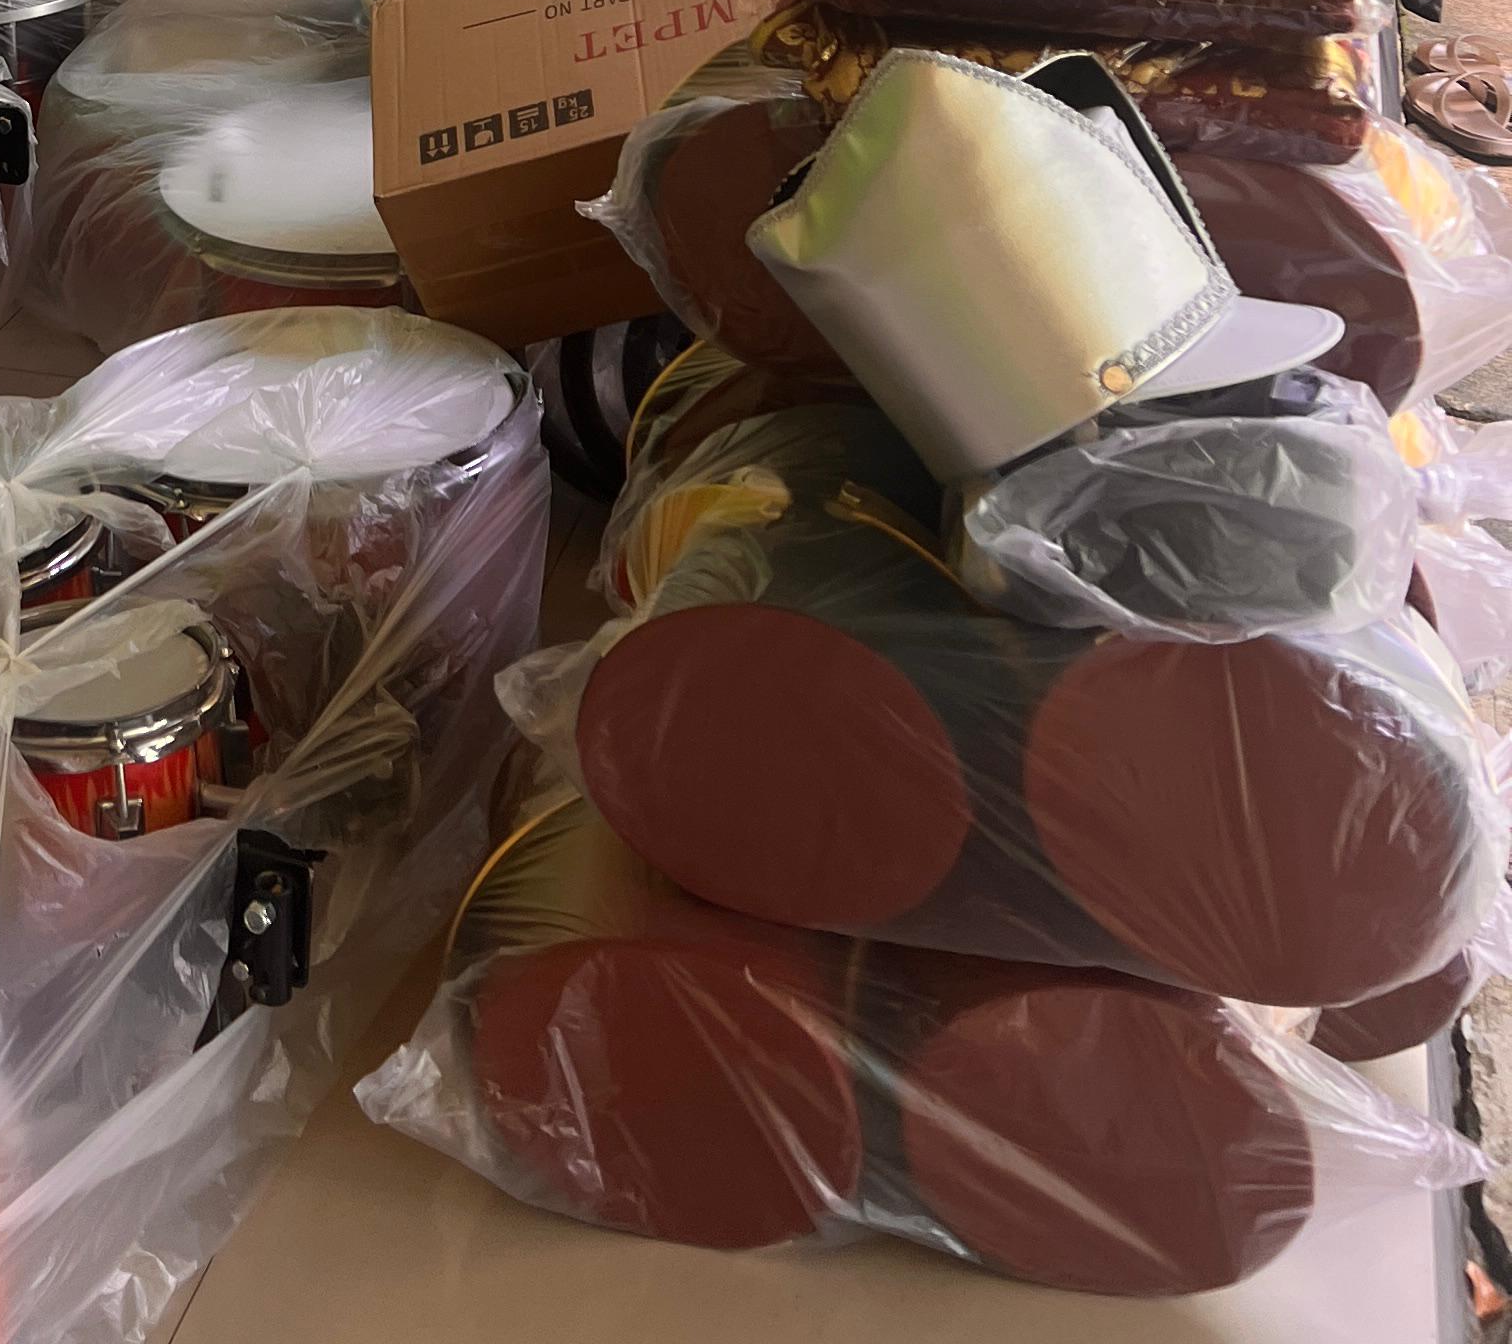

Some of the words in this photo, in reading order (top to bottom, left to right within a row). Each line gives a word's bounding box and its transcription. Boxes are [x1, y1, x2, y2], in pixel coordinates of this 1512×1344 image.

[544, 0, 572, 20] NO
[557, 97, 578, 110] kg
[569, 105, 589, 121] 25
[519, 119, 539, 133] 15
